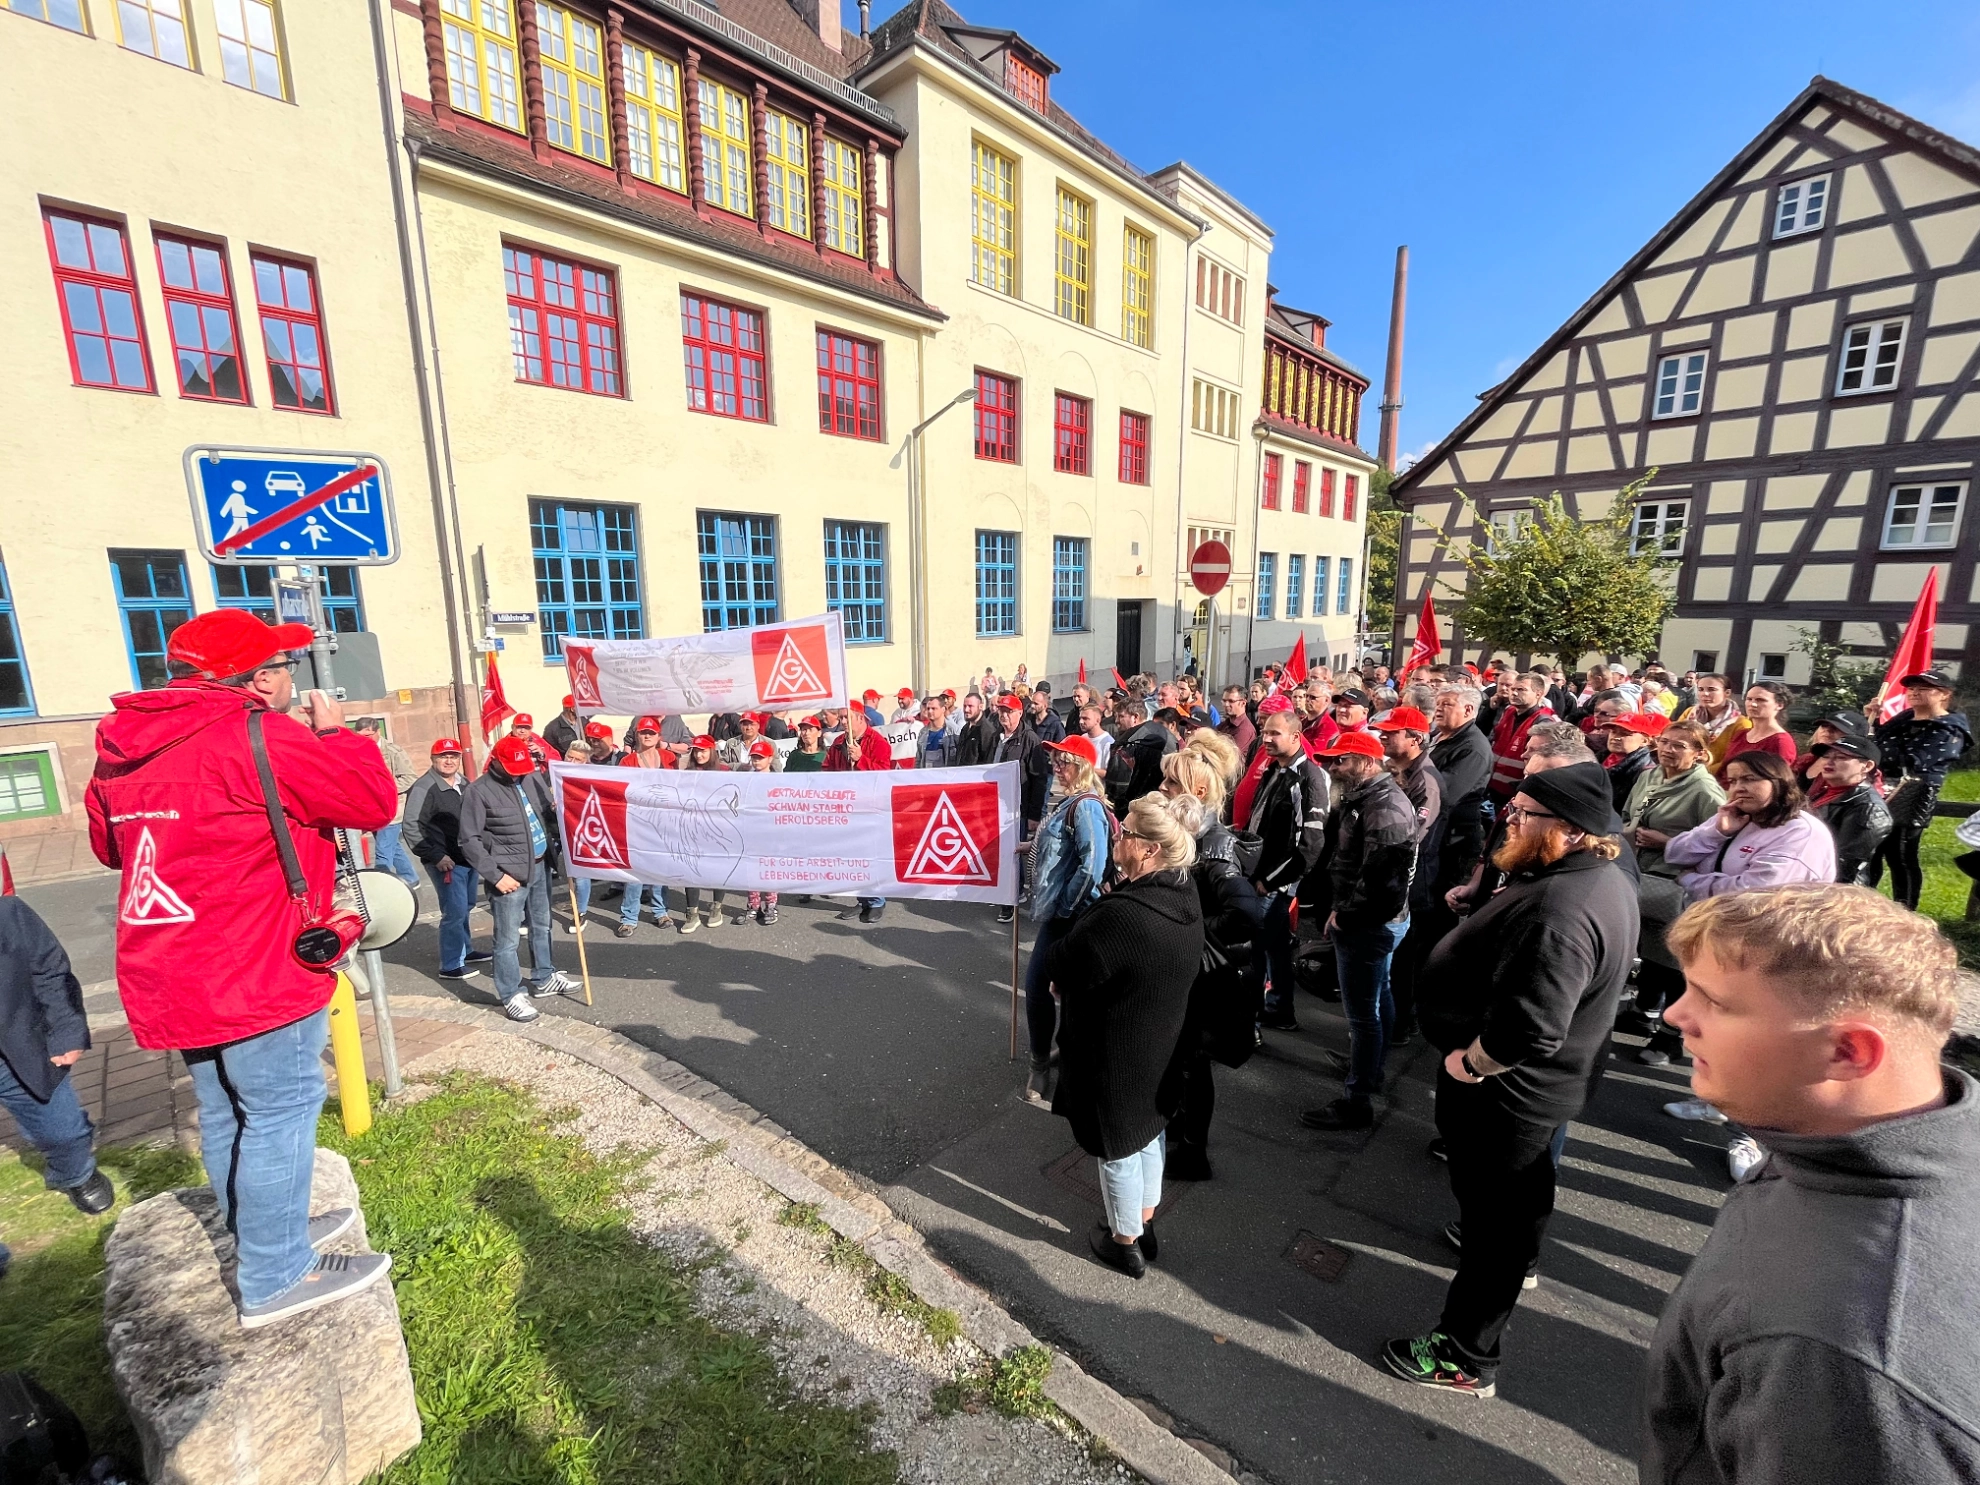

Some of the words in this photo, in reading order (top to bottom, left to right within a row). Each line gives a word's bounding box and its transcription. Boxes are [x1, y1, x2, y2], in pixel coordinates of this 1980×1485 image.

[766, 788, 856, 800] VERTRAUENSLEUTE
[767, 802, 810, 812] SCHWAN
[812, 803, 854, 814] STABILO
[774, 814, 849, 825] HEROLDSBERG
[847, 859, 870, 868] UND
[759, 870, 871, 881] LEBENSBEDINGUNGEN
